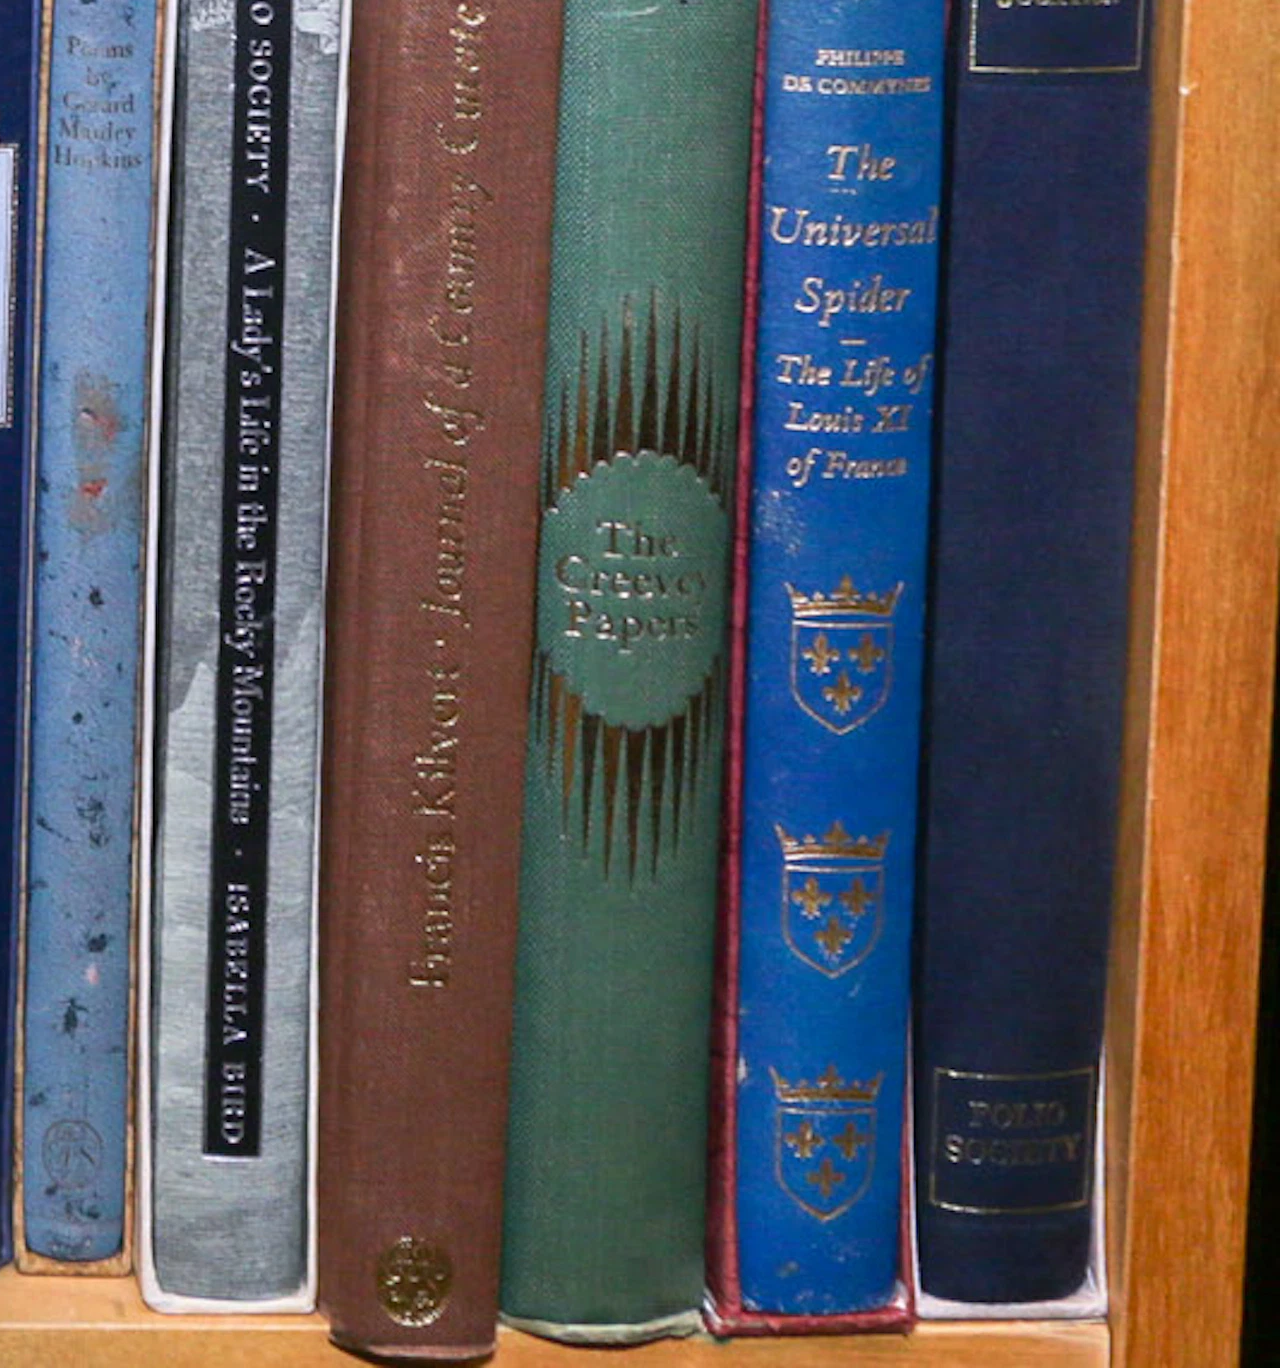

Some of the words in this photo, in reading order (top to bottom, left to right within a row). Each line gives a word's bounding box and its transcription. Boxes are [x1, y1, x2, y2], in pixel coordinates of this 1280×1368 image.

[246, 39, 274, 193] SOCIETY
[827, 144, 896, 180] The
[767, 207, 937, 246] Universal
[244, 245, 276, 274] A
[795, 276, 911, 327] Spider
[776, 354, 831, 385] The
[785, 402, 864, 432] Louis
[871, 406, 912, 432] XI
[223, 883, 249, 1047] ISABELLA
